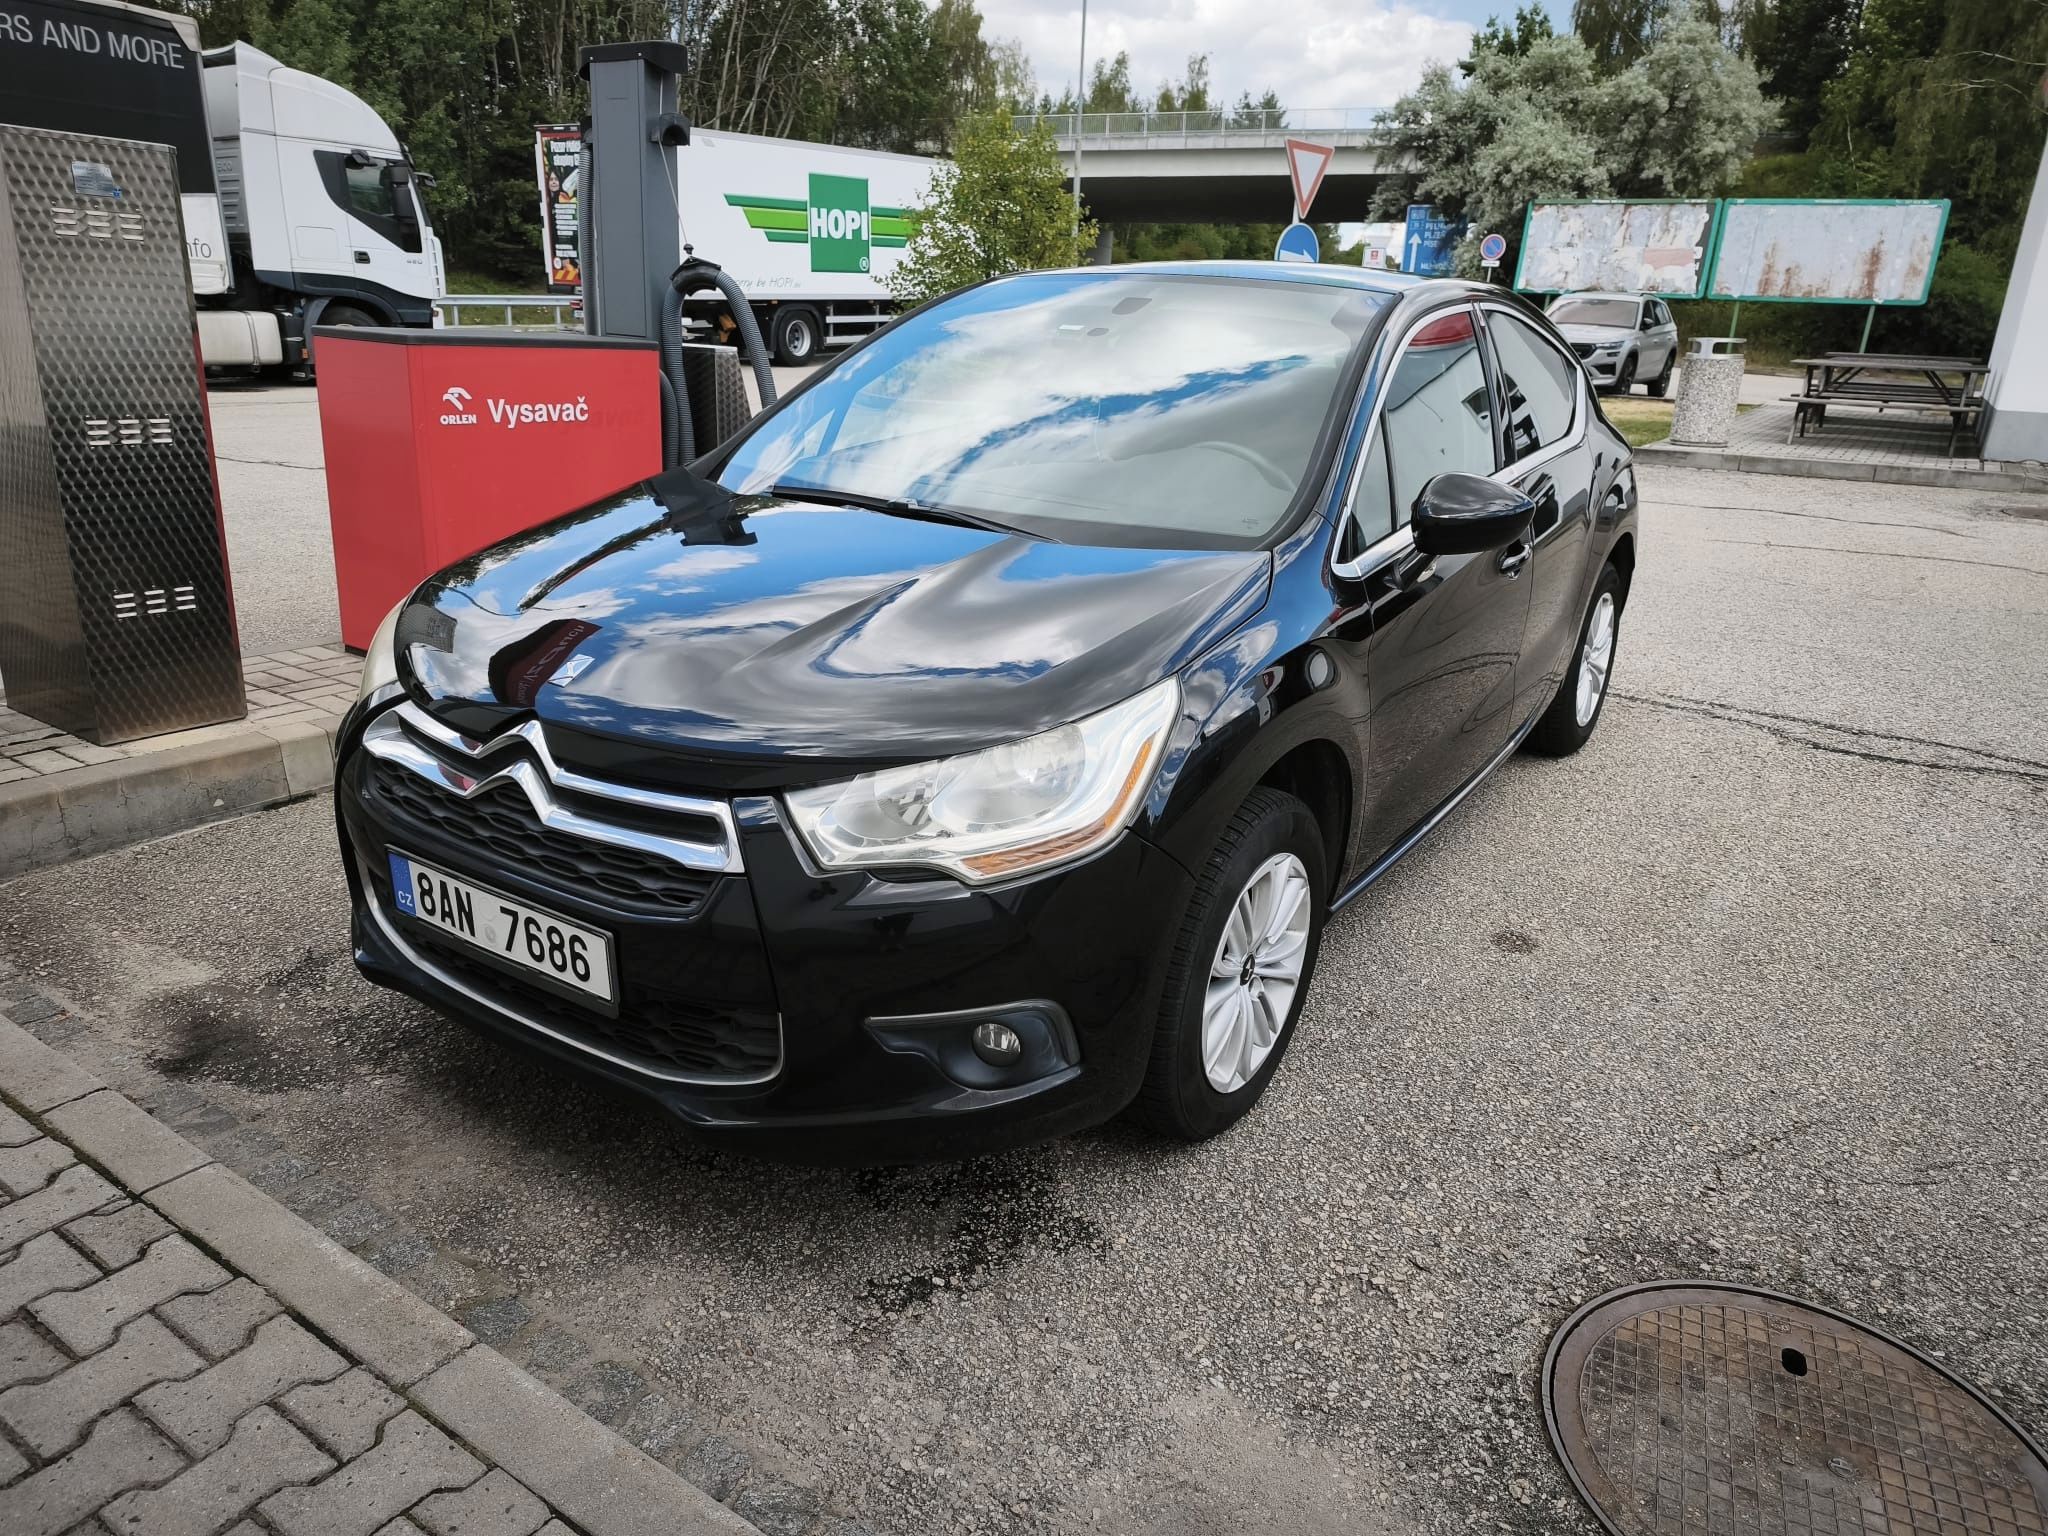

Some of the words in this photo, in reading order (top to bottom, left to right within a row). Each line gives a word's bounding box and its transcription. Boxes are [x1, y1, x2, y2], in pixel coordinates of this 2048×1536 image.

[43, 20, 100, 54] AND
[107, 31, 185, 69] MORE
[810, 207, 869, 241] HOPI
[440, 414, 477, 425] ORLEN
[487, 396, 589, 429] Vysavač
[398, 890, 413, 907] CZ
[417, 872, 476, 938] 8AN
[499, 905, 591, 983] 7686
